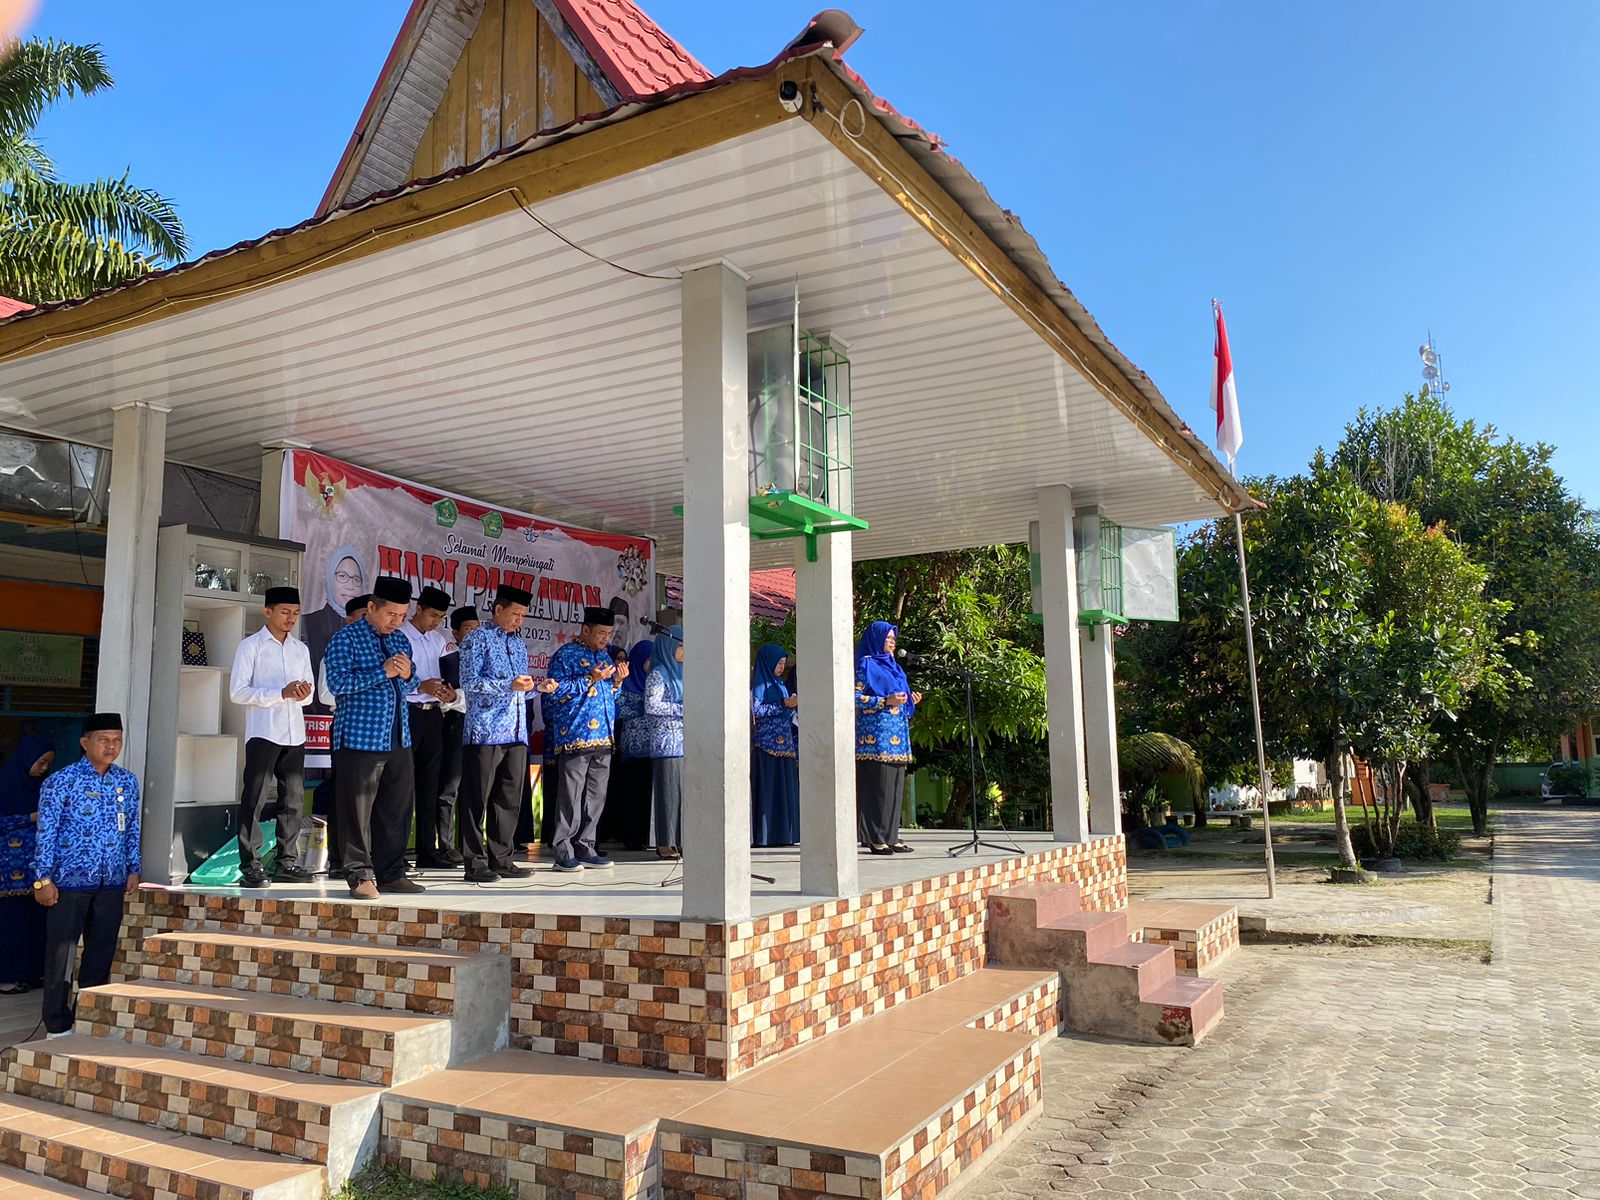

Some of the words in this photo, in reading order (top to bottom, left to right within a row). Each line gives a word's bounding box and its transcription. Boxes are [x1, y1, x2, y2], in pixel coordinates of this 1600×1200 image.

[444, 534, 487, 558] Selamat
[492, 544, 555, 574] Memperingati
[525, 627, 551, 641] 2023
